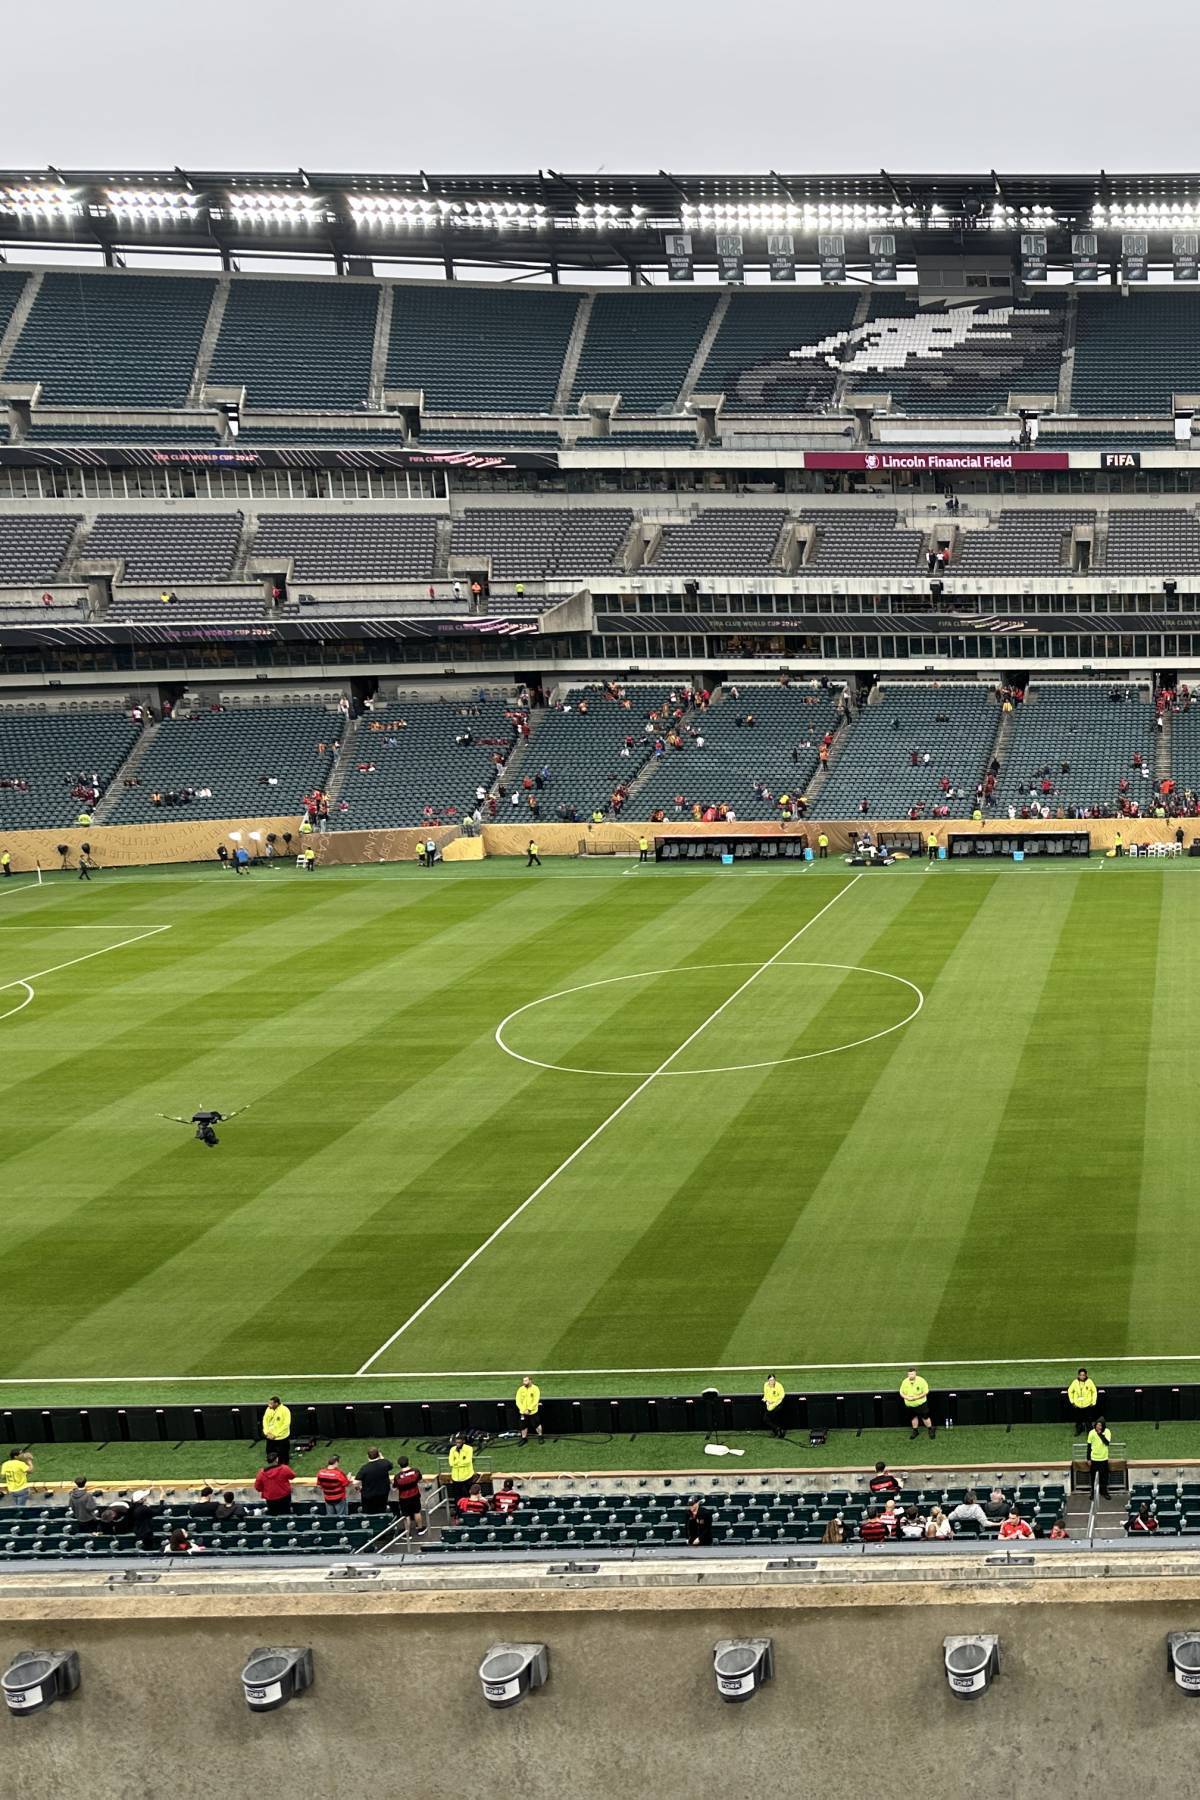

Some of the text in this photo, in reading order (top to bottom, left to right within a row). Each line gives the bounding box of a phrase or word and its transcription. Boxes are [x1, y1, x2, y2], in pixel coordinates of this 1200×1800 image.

[872, 236, 893, 256] 70
[1023, 236, 1045, 256] 15
[1074, 236, 1095, 256] 40
[882, 455, 1012, 468] Lincoln Financial Field
[1106, 454, 1135, 467] FIFA
[722, 1680, 742, 1689] TORK
